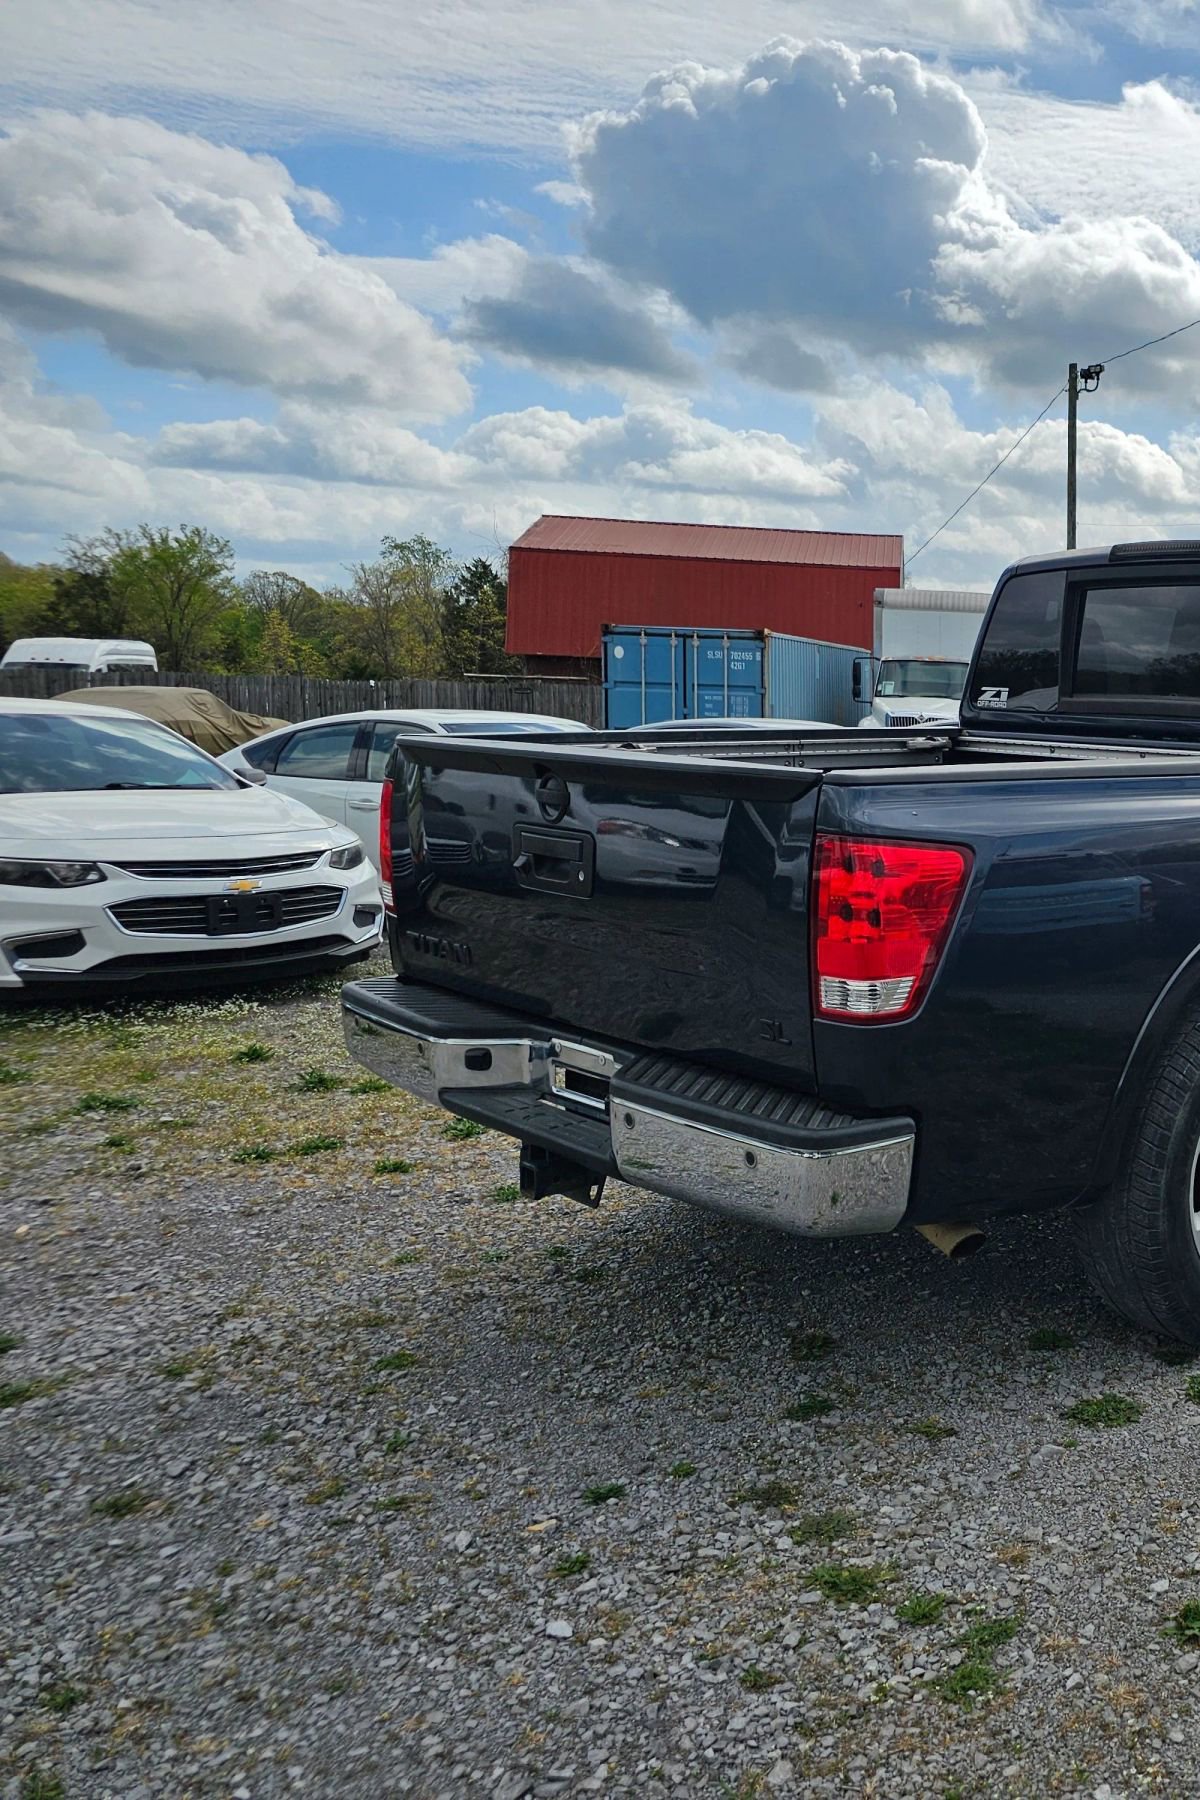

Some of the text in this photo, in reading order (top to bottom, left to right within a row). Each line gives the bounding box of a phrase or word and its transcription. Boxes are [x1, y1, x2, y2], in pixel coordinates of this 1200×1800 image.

[707, 650, 723, 659] SLSU
[730, 651, 753, 661] 702455
[730, 661, 746, 670] 42G1
[977, 700, 1007, 709] OFF-ROAD
[405, 929, 472, 966] TITAN
[759, 1018, 792, 1046] SL
